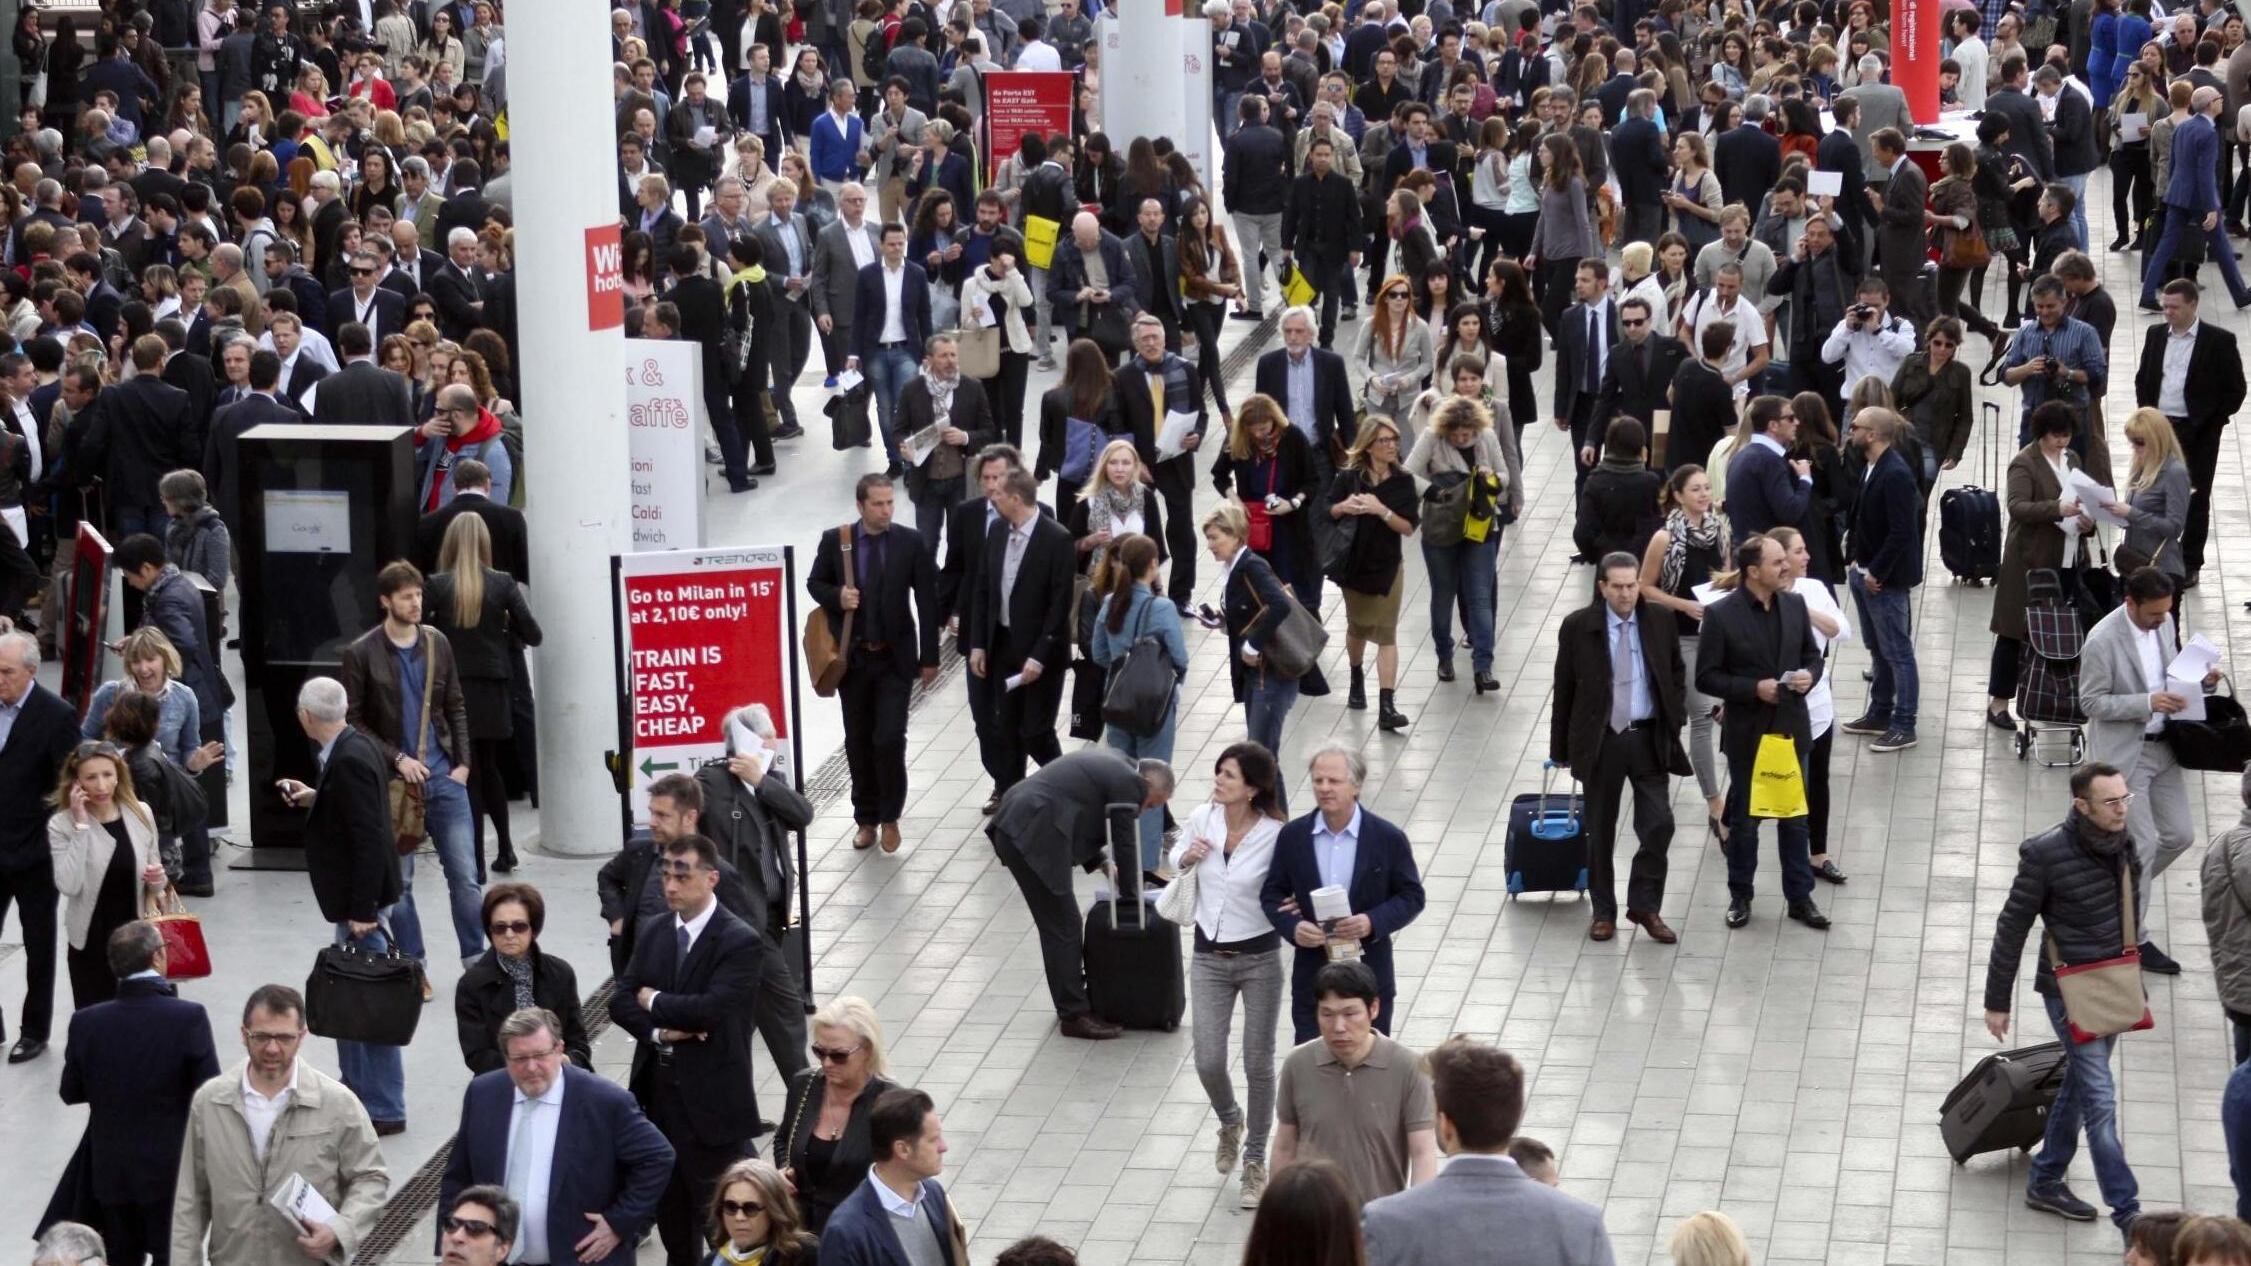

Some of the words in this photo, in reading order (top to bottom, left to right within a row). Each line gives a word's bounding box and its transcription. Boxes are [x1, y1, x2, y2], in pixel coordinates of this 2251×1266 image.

[641, 358, 664, 387] &
[631, 504, 662, 520] Caldi
[633, 528, 666, 544] dwich
[630, 589, 652, 604] Go
[657, 588, 673, 602] to
[678, 585, 724, 601] Milan
[729, 582, 745, 598] in
[631, 610, 648, 624] at
[652, 606, 700, 624] 2,10€
[705, 603, 747, 622] only!
[633, 648, 696, 669] TRAIN
[702, 646, 722, 665] IS
[636, 671, 694, 692] FAST,
[636, 695, 695, 715] EASY,
[637, 716, 706, 737] CHEAP
